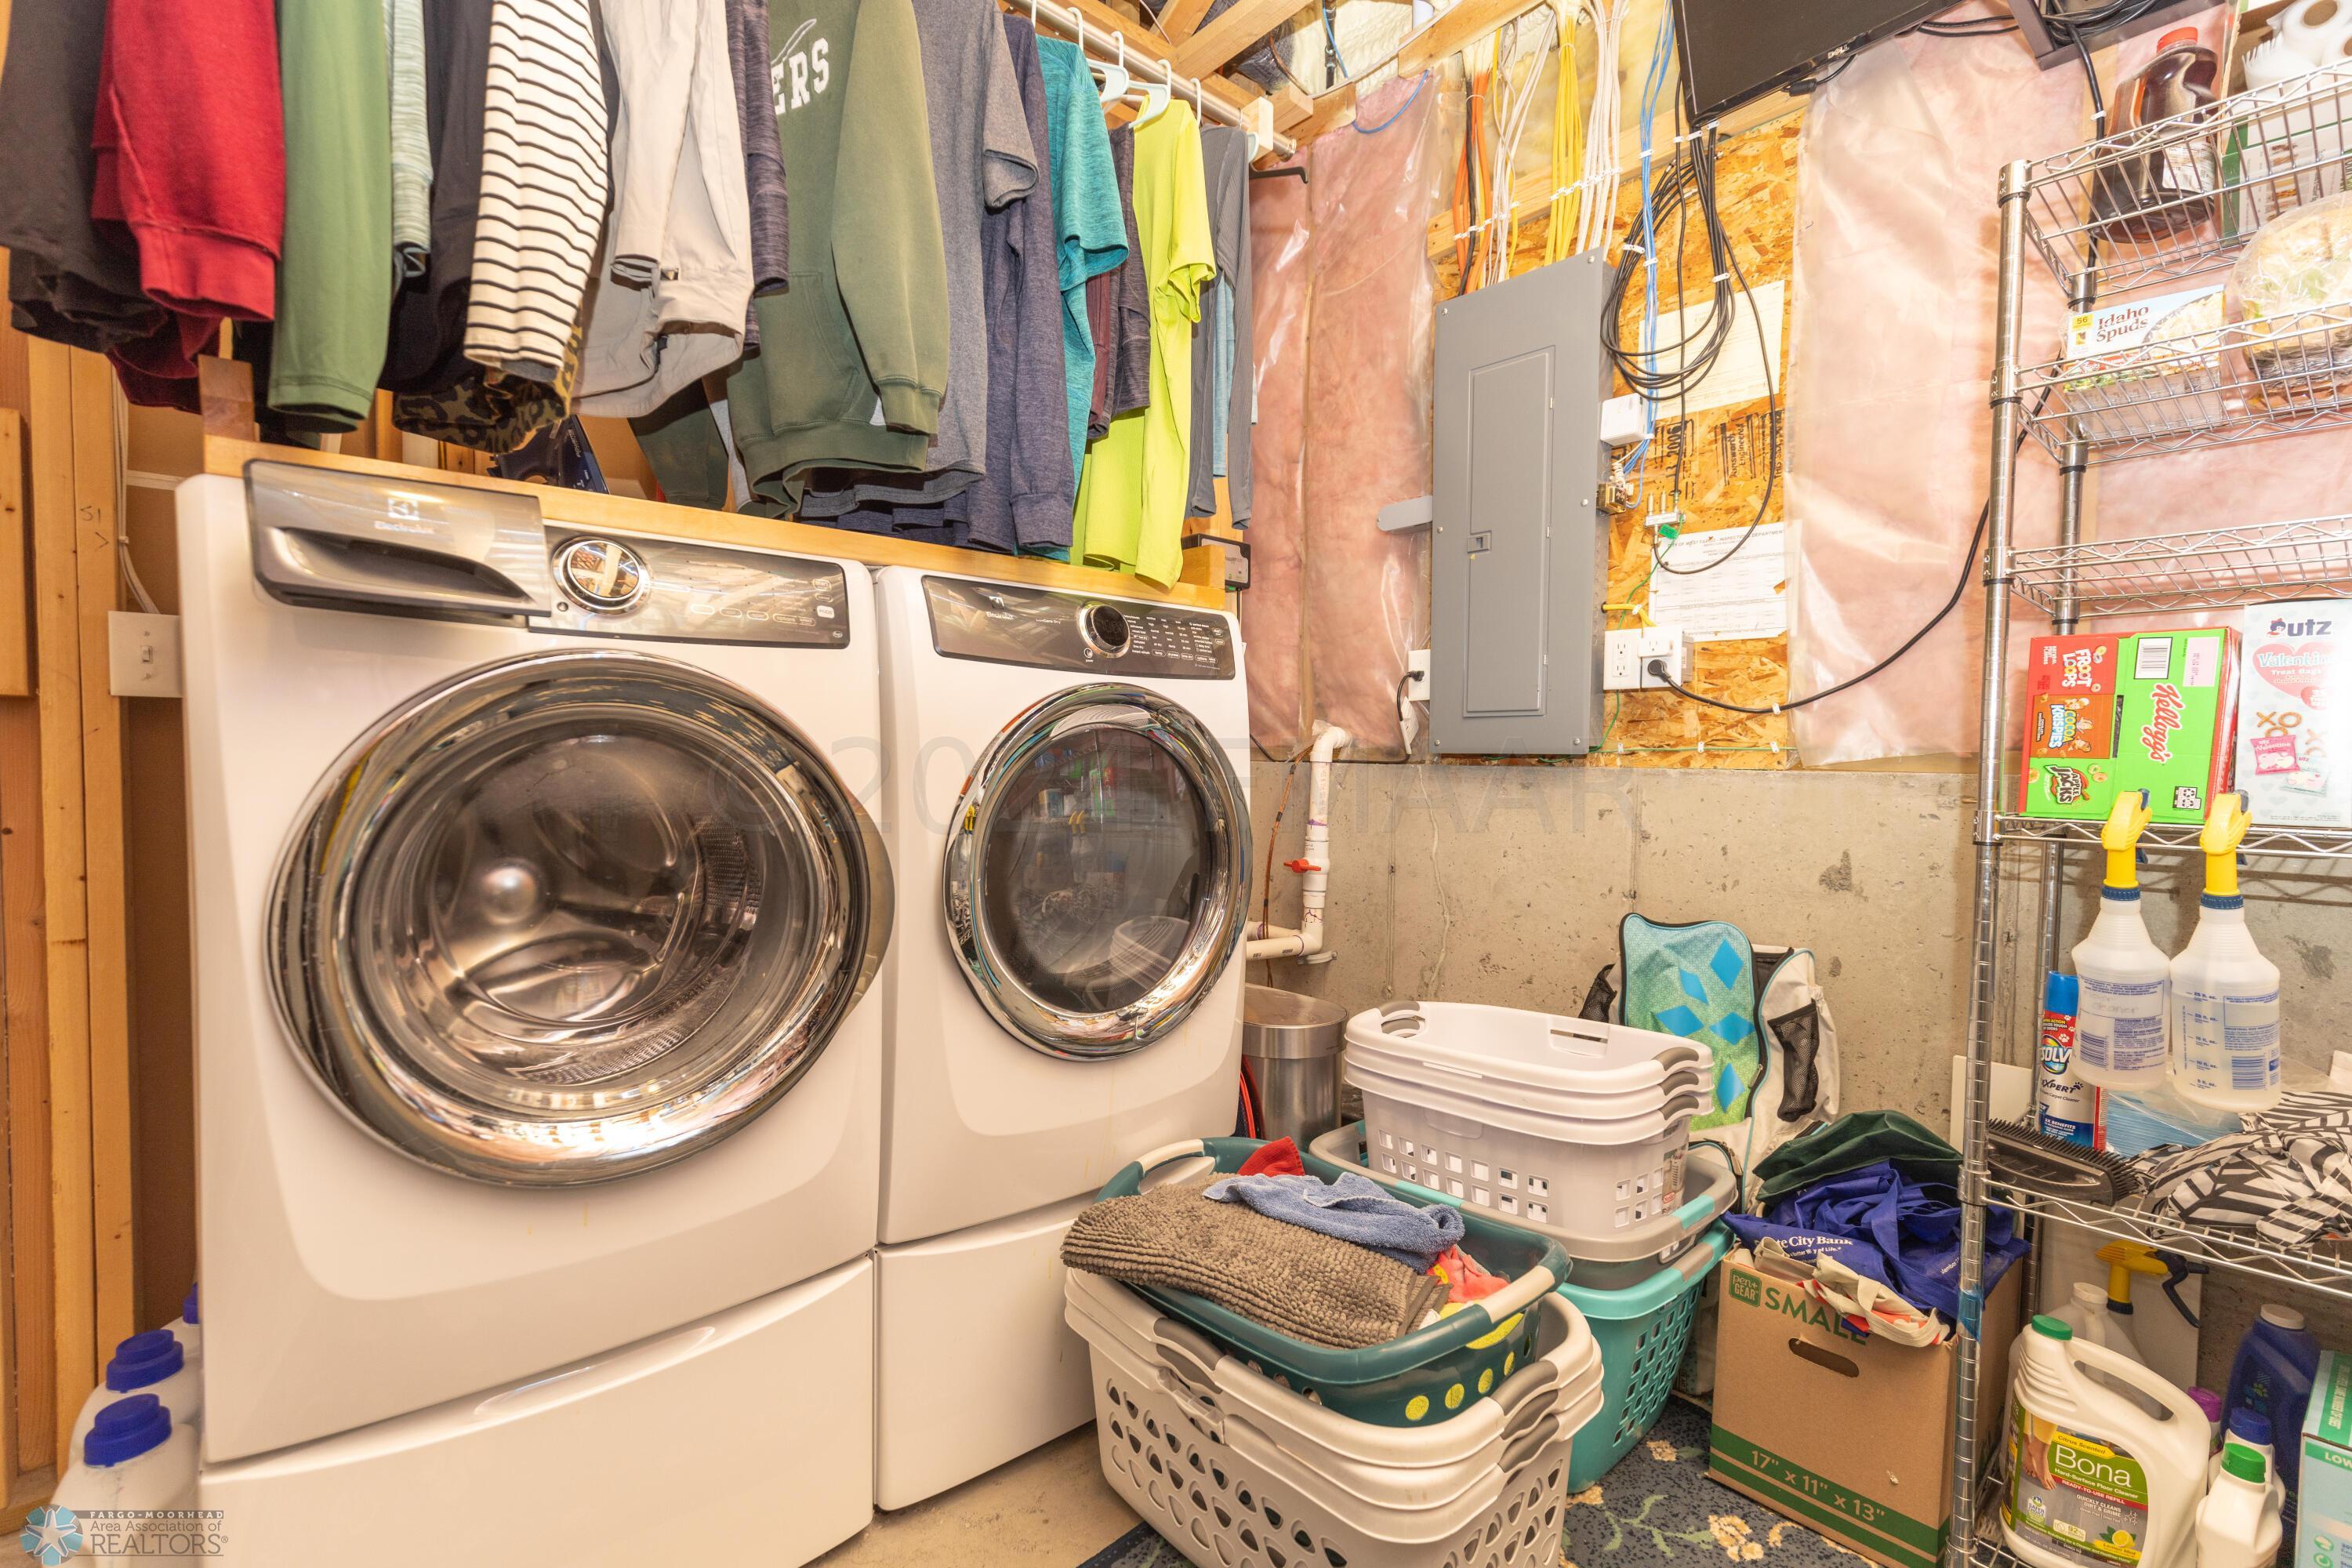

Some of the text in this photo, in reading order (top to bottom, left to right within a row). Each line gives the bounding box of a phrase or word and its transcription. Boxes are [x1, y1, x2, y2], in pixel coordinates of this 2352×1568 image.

[1828, 44, 1849, 59] DELL
[2077, 316, 2088, 325] 56
[2098, 307, 2149, 329] Idaho
[2096, 318, 2148, 343] Spuds
[1737, 423, 1747, 466] Engineered
[2287, 619, 2332, 637] utz
[2061, 652, 2077, 688] LOOPS
[2075, 648, 2092, 687] FROOT
[2049, 704, 2064, 749] KRISPIES
[2063, 710, 2077, 742] COCOA
[2140, 683, 2185, 764] Kellogg's
[2048, 766, 2073, 804] JACKS
[2071, 772, 2081, 795] APPLE
[2052, 1120, 2076, 1130] BENEFITS
[1788, 1236, 1816, 1247] City
[1817, 1236, 1853, 1245] Bank
[1733, 1274, 1758, 1290] pen+
[2058, 1435, 2106, 1454] Citrus Scented
[2055, 1443, 2132, 1488] Bona
[2325, 1451, 2352, 1467] LOW
[1751, 1450, 1886, 1521] 17" x 11" x 13"
[2054, 1467, 2139, 1499] Hard-Surface Floor Cleaner
[2062, 1479, 2125, 1504] READY-TO-USE REFILL
[2076, 1494, 2122, 1512] QUICKLY CLEANS
[2084, 1501, 2096, 1510] DIRT
[2103, 1508, 2122, 1517] GRIME
[2103, 1543, 2136, 1556] Lemon Mint
